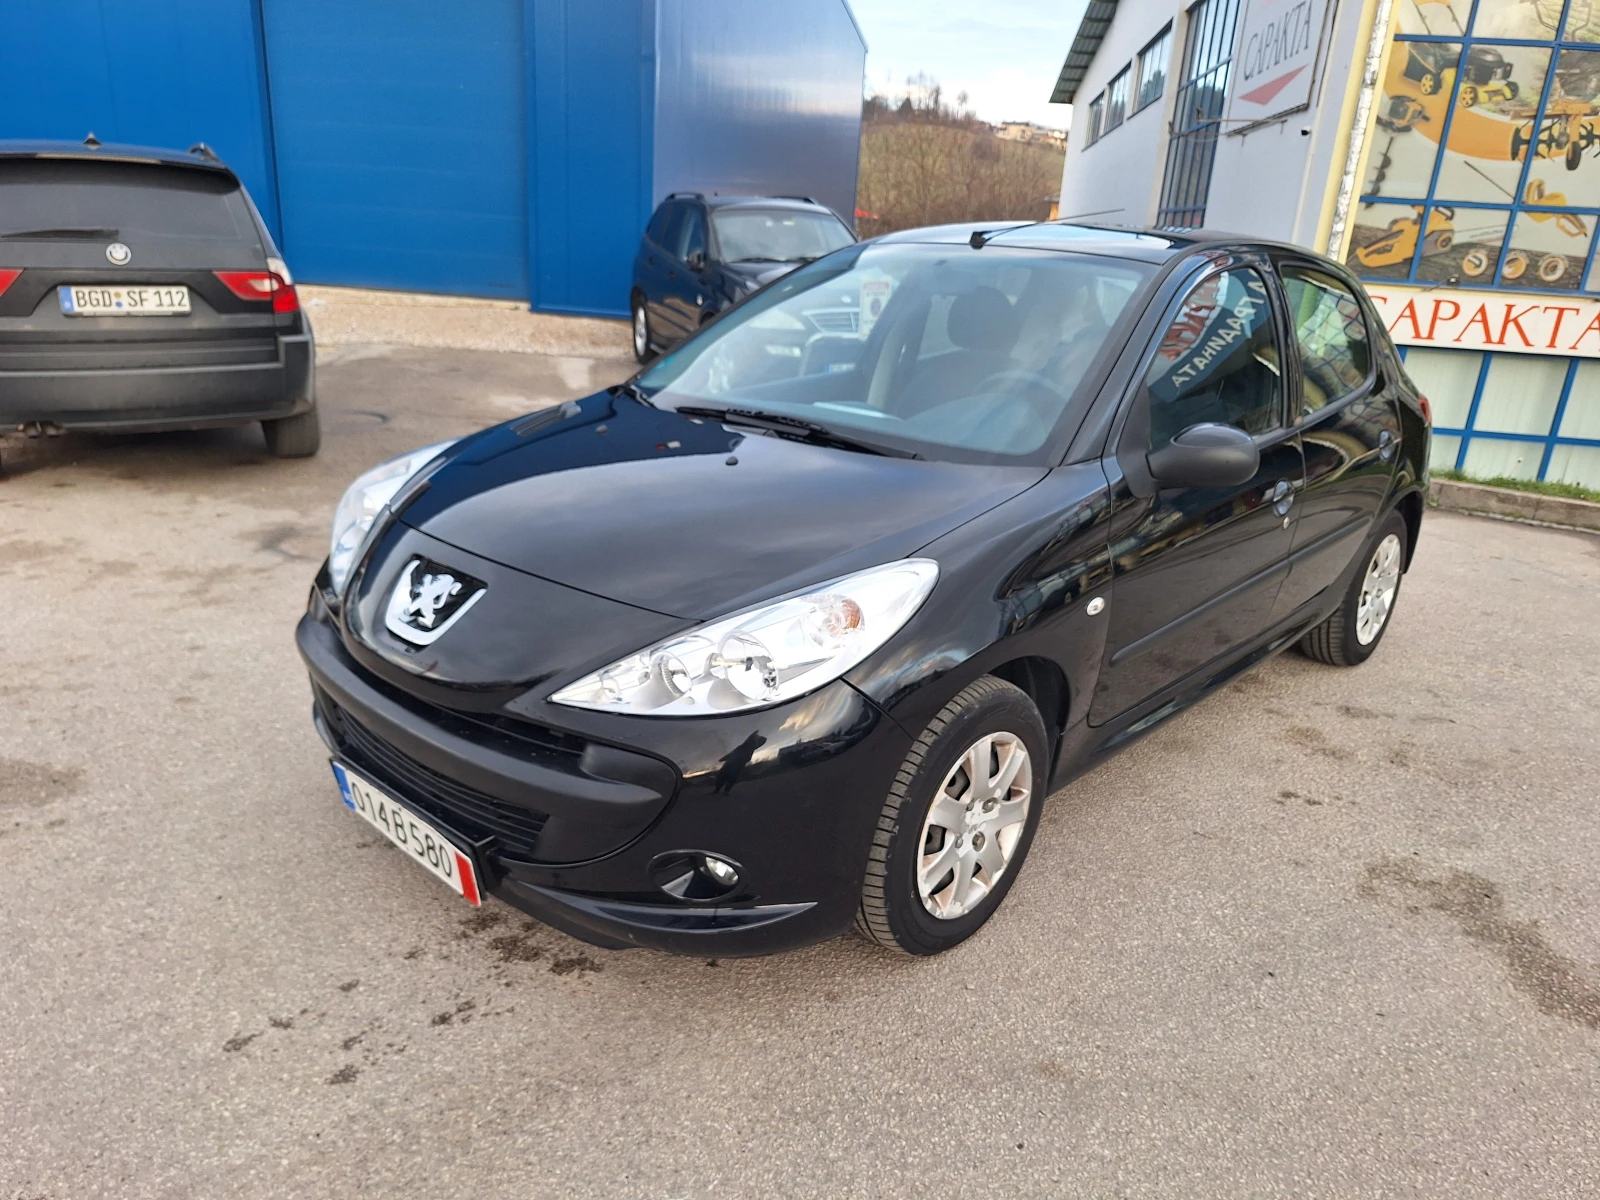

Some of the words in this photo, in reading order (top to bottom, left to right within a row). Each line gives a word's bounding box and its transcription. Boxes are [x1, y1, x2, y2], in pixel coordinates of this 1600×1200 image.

[75, 289, 113, 308] BGD
[126, 289, 149, 308] SF
[153, 289, 187, 308] 112
[351, 782, 452, 878] 014B580
